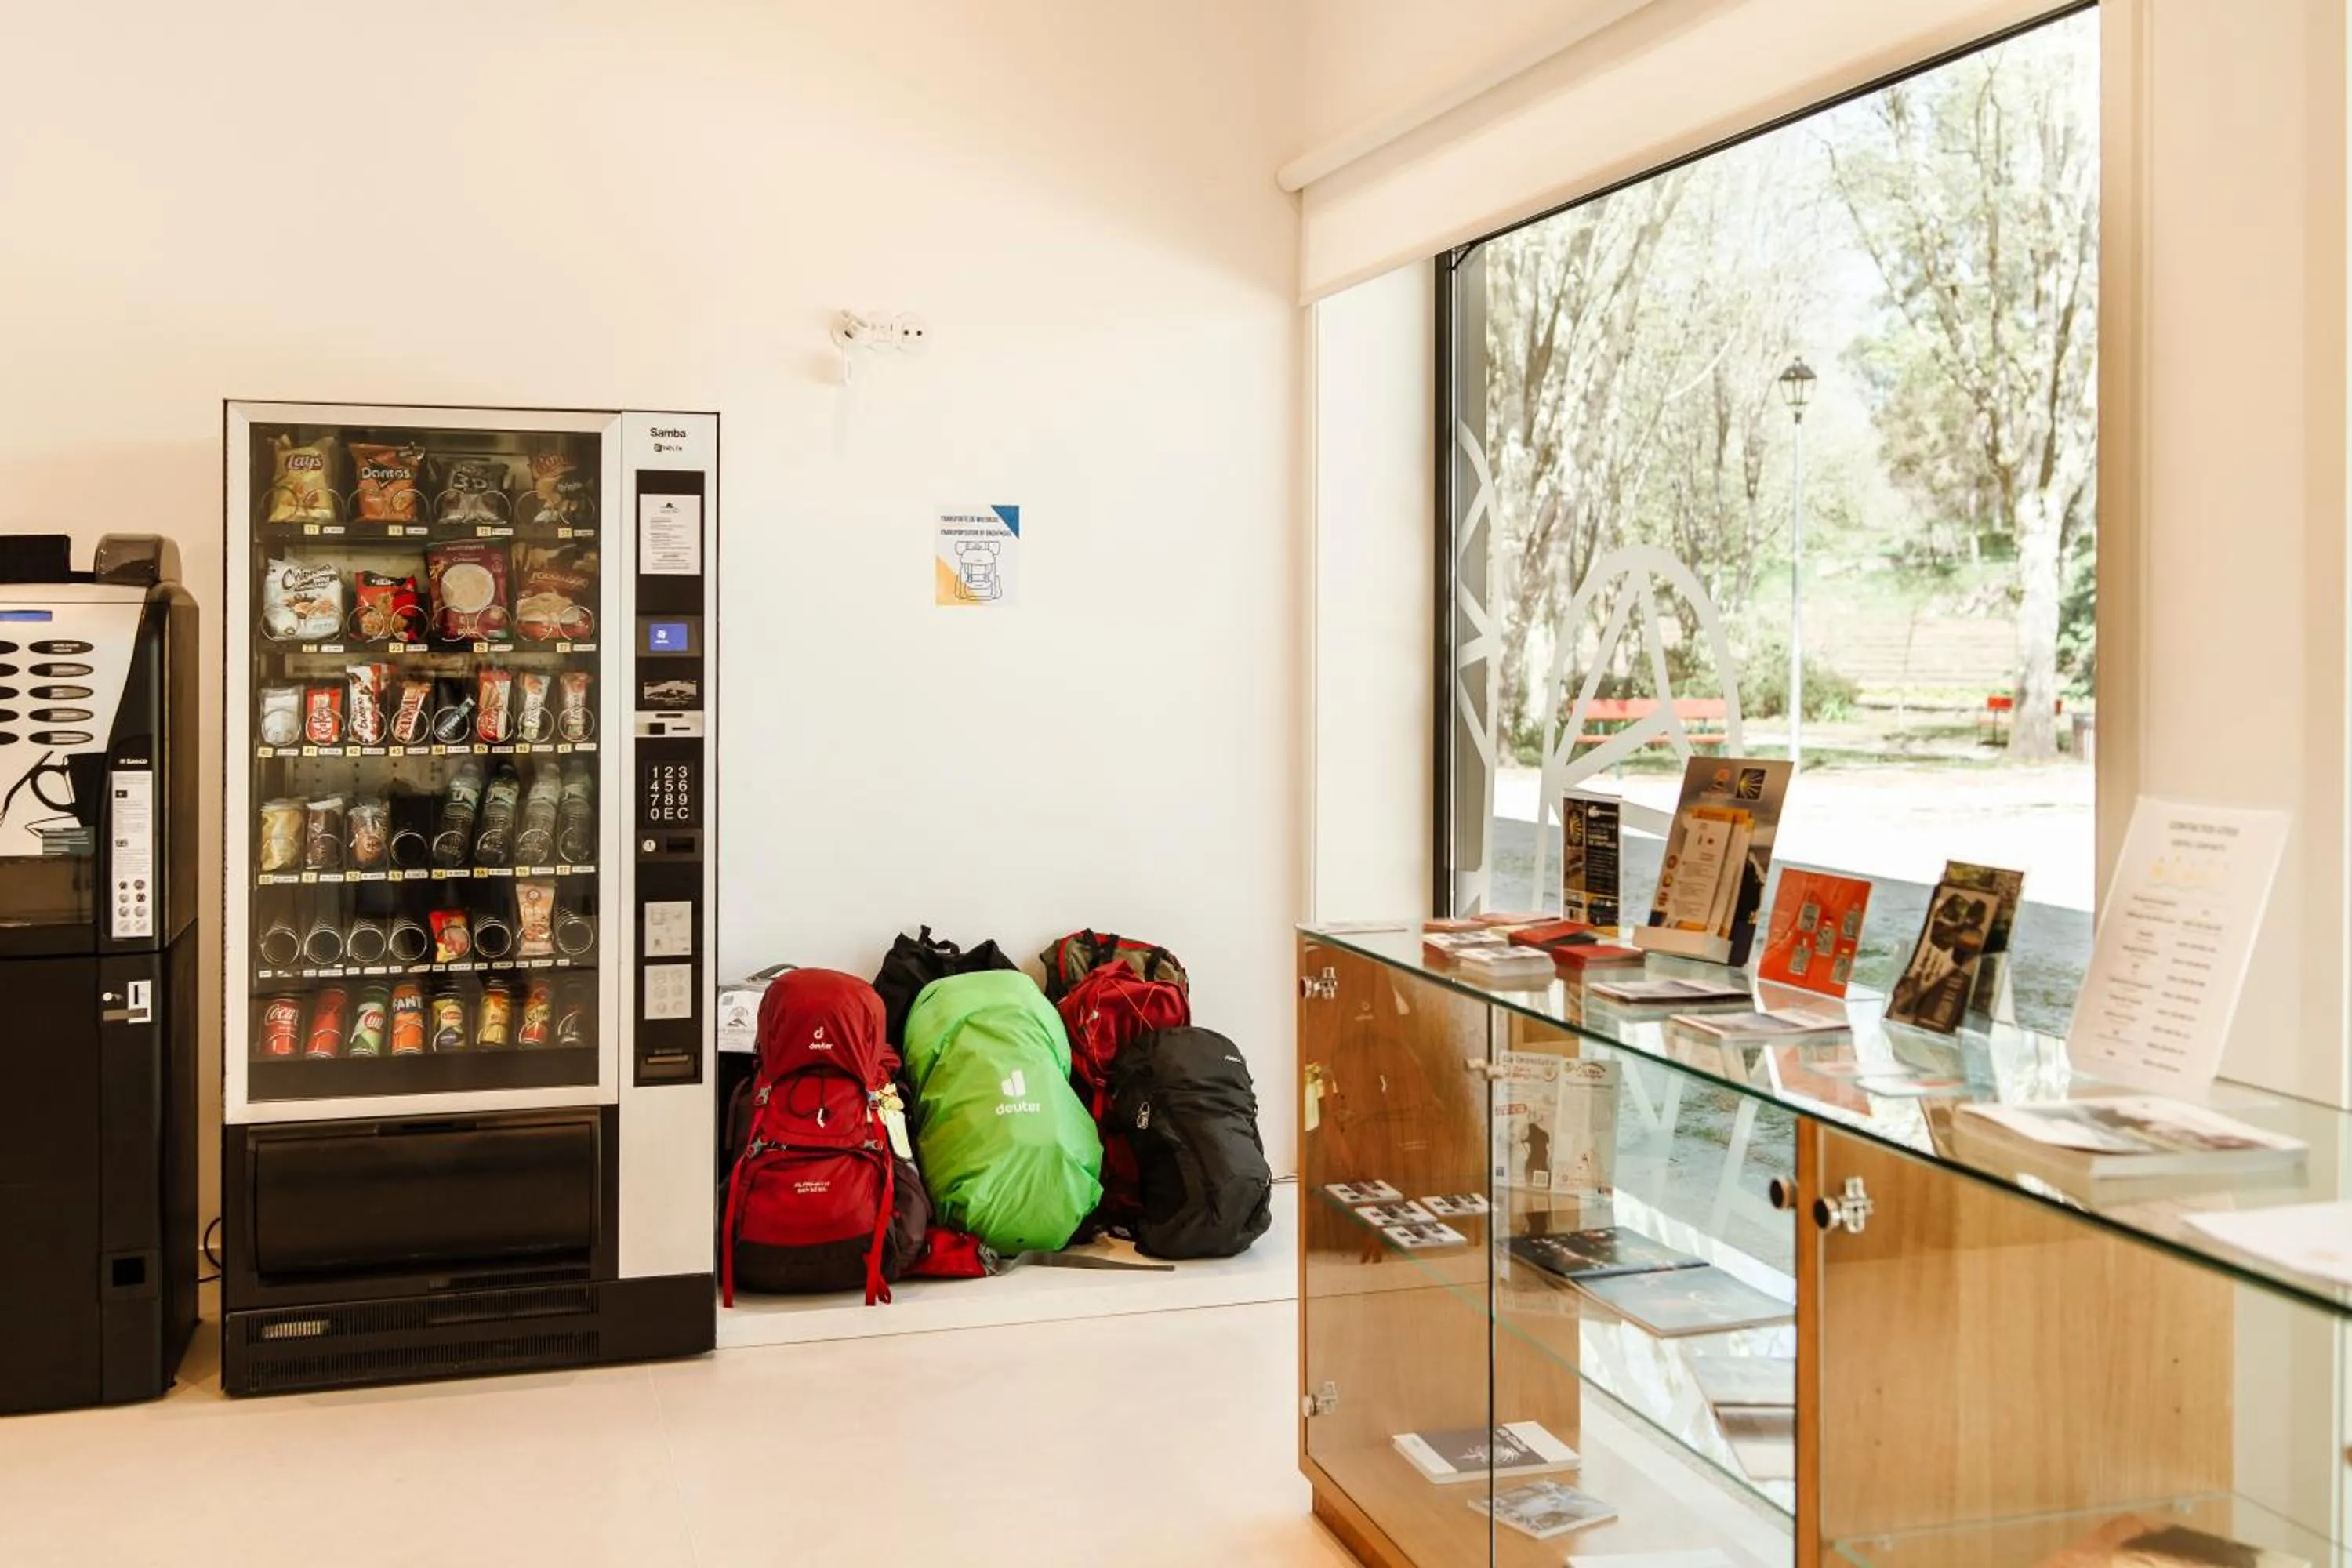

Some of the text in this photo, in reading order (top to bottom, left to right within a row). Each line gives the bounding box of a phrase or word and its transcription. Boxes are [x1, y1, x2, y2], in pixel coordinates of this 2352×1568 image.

[650, 427, 687, 438] Samba
[361, 466, 411, 479] Doritos
[652, 765, 688, 779] 1 2 3
[650, 779, 688, 792] 4 5 6
[650, 793, 688, 806] 7 8 9
[650, 807, 689, 820] 0 E C
[393, 995, 423, 1011] FANT
[808, 1042, 833, 1051] deuter
[995, 1101, 1041, 1116] deuter
